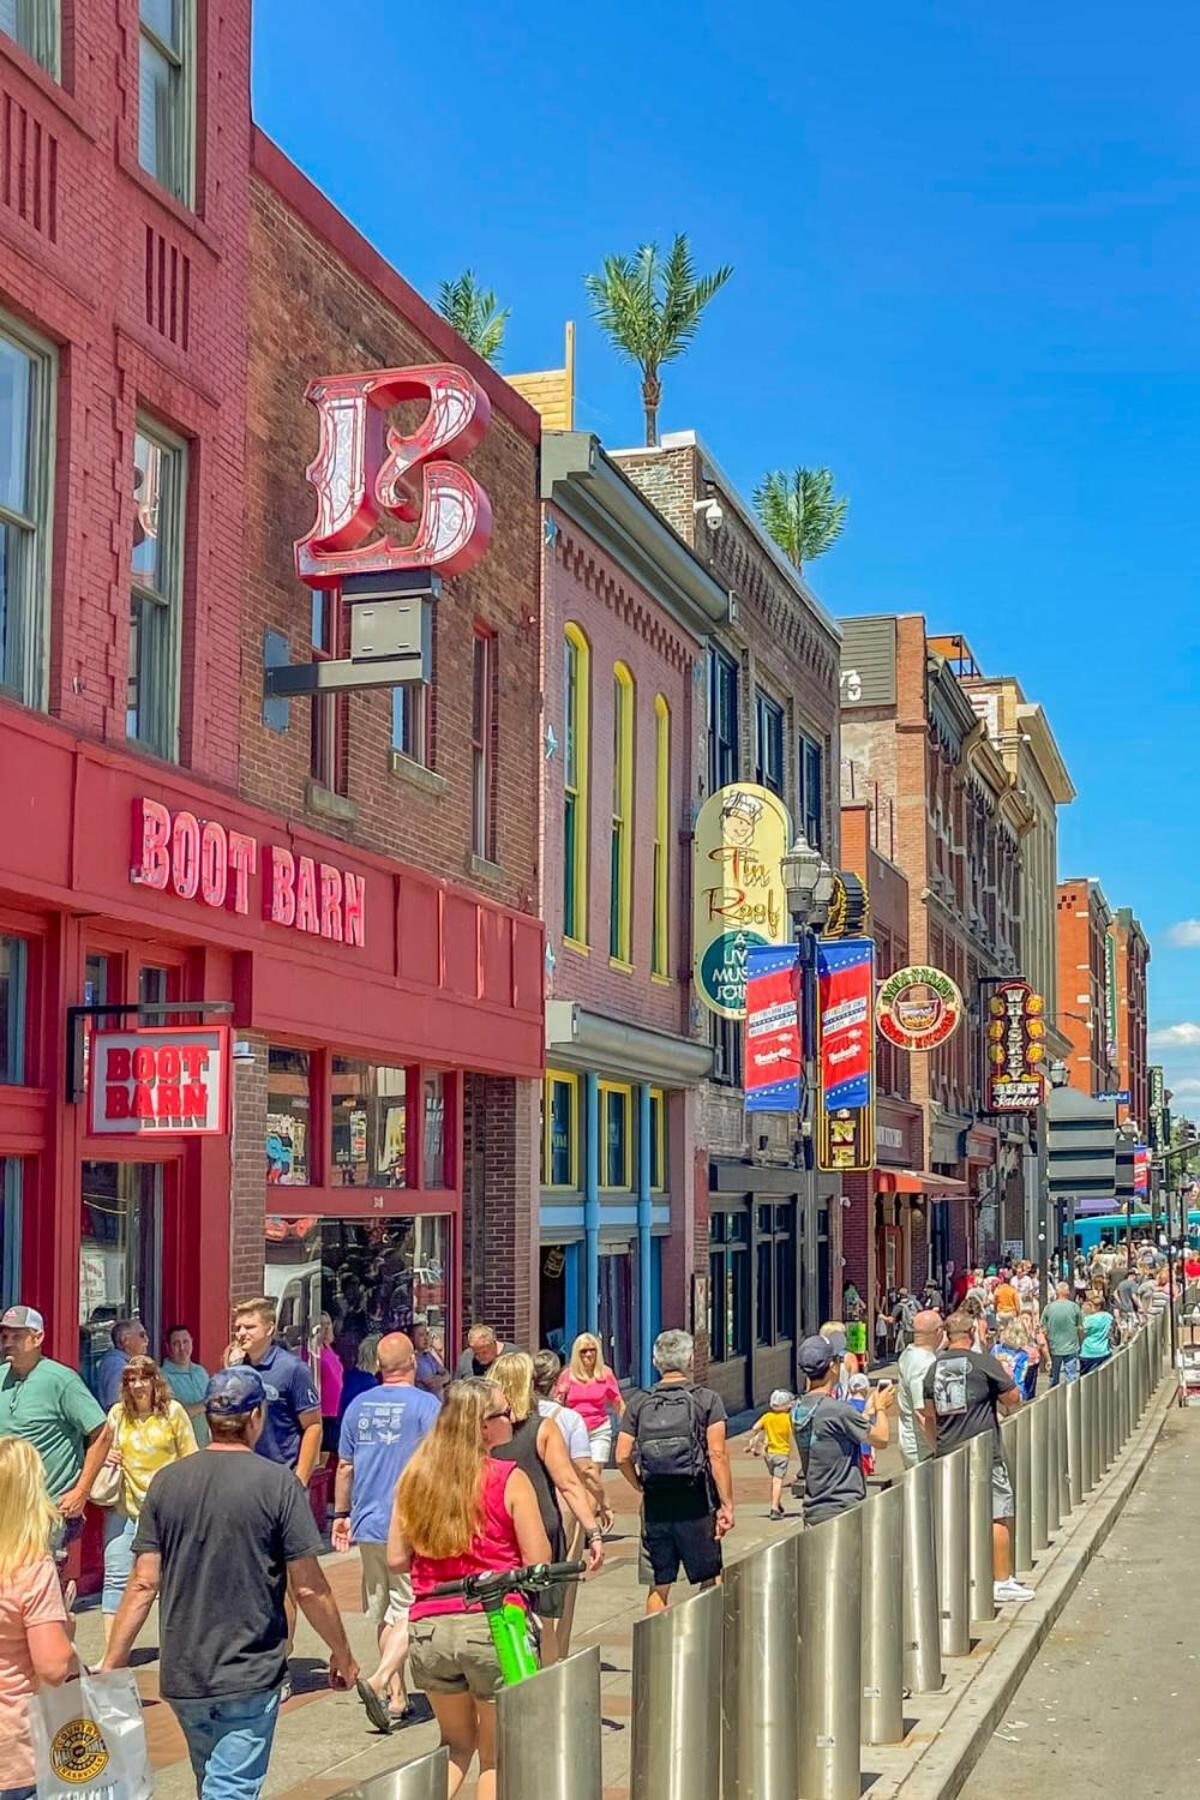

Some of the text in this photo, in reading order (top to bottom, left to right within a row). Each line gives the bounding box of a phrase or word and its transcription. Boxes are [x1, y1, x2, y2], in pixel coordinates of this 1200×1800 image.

[294, 363, 492, 590] B
[133, 797, 366, 948] BOOT BARN
[708, 846, 769, 887] Tin
[702, 887, 779, 937] Roof
[724, 949, 747, 965] LIV
[1005, 988, 1026, 1081] WHISKEY
[105, 1045, 209, 1082] BOOT
[105, 1082, 208, 1119] BARN
